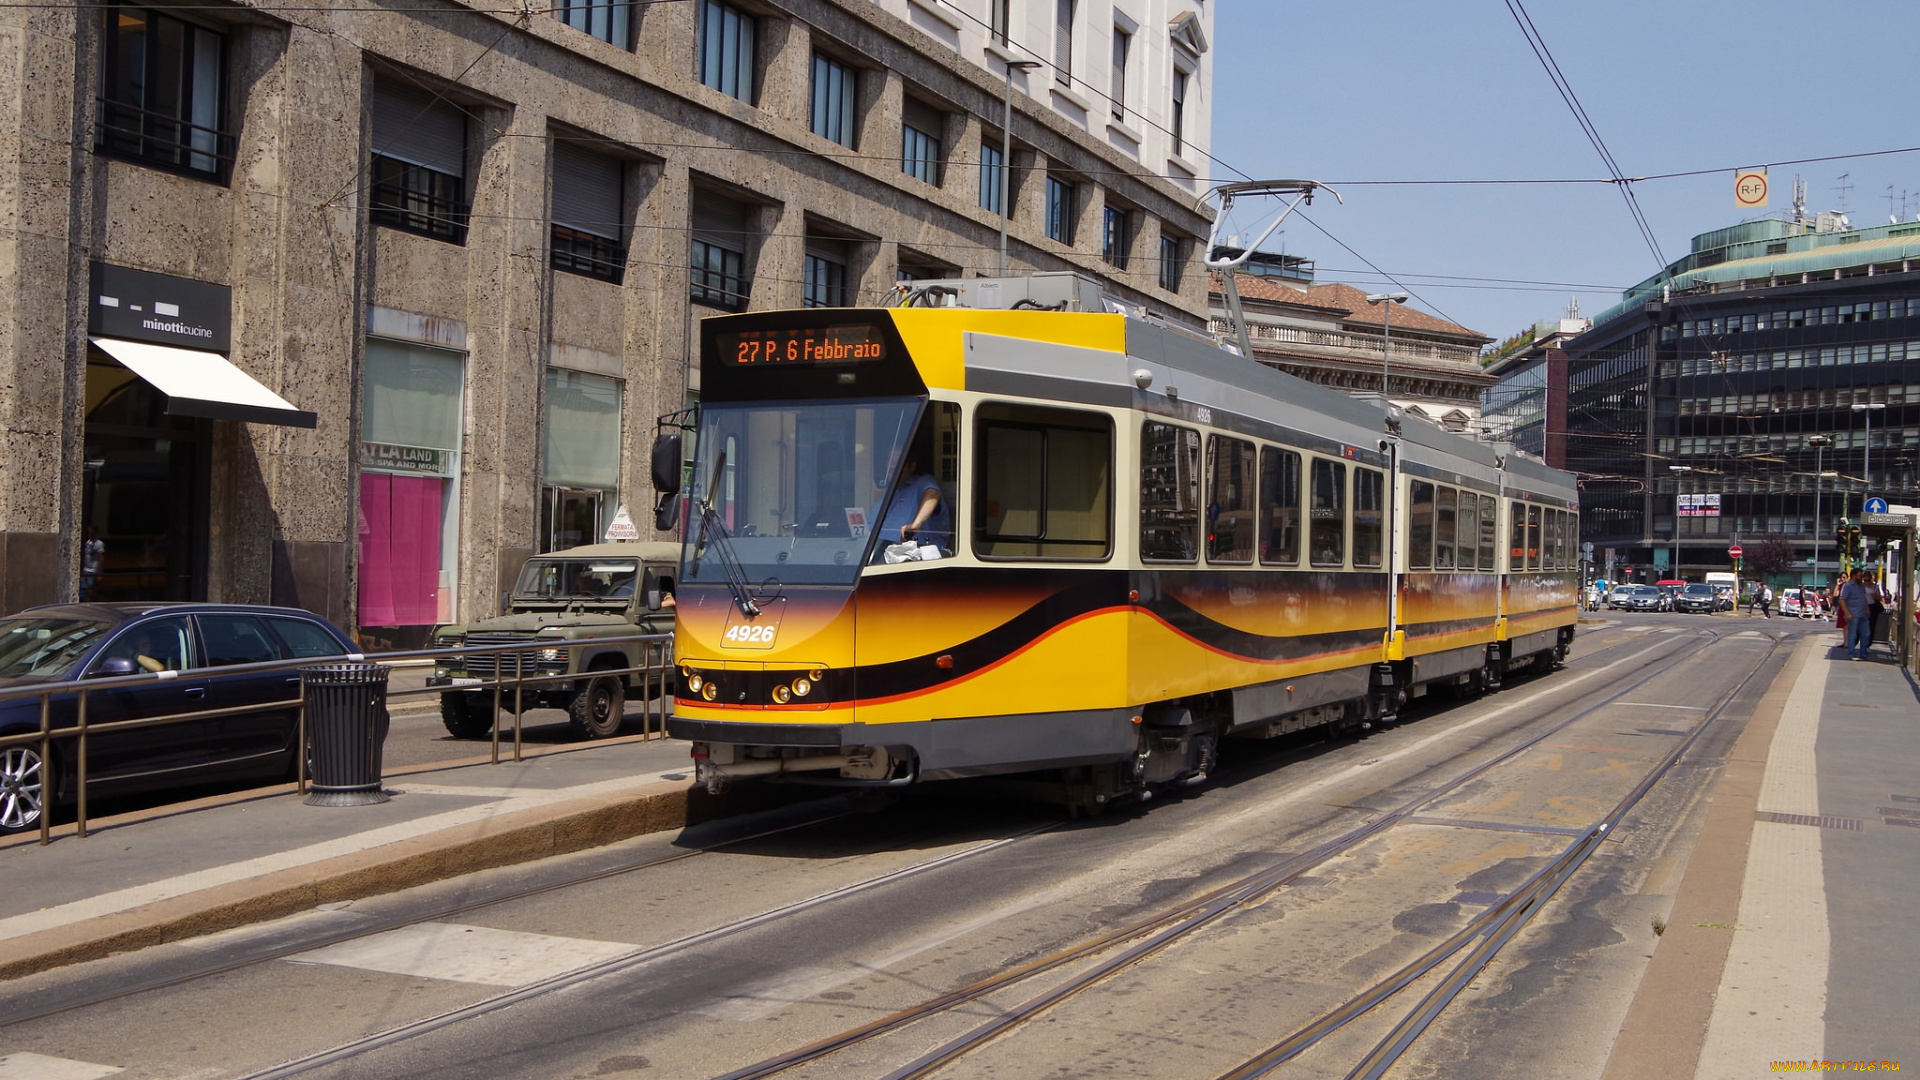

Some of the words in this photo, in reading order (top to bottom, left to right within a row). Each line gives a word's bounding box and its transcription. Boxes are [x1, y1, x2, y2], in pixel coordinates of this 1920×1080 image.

[1741, 184, 1762, 194] R-F
[143, 319, 212, 338] minotticucine
[738, 341, 760, 363] 27
[765, 340, 780, 362] P.
[787, 339, 798, 361] 6
[804, 338, 881, 360] Febbraio
[1197, 407, 1211, 423] 4926
[403, 447, 432, 462] LAND
[376, 459, 394, 467] SPA
[396, 461, 416, 469] AND
[853, 525, 865, 536] 27
[726, 625, 775, 642] 4926
